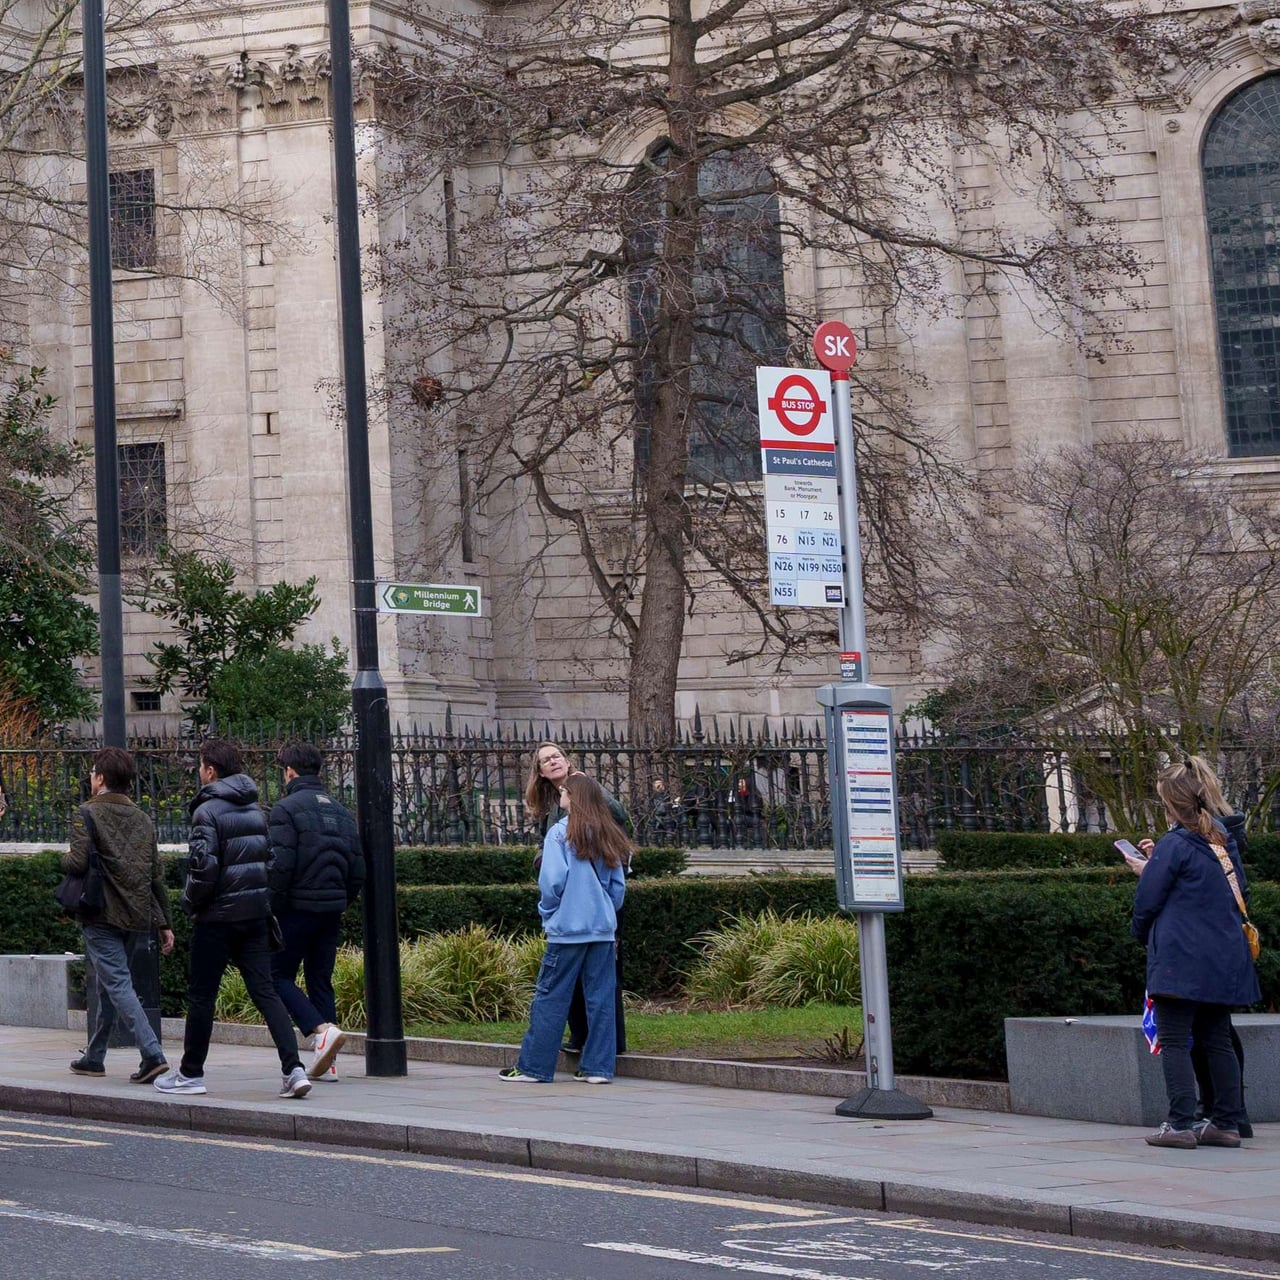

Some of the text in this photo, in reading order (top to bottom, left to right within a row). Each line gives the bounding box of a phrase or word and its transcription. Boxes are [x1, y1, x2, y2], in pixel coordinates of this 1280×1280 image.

[824, 335, 851, 358] SK
[782, 400, 815, 410] BUS STOP
[773, 456, 833, 467] St Paul's Cathedral
[776, 509, 833, 521] 15 17 26
[776, 534, 838, 547] 76 N15 N21
[774, 561, 842, 573] N26 N199 N550
[414, 590, 460, 601] Millennium
[774, 588, 797, 597] N551
[423, 600, 451, 610] Bridge
